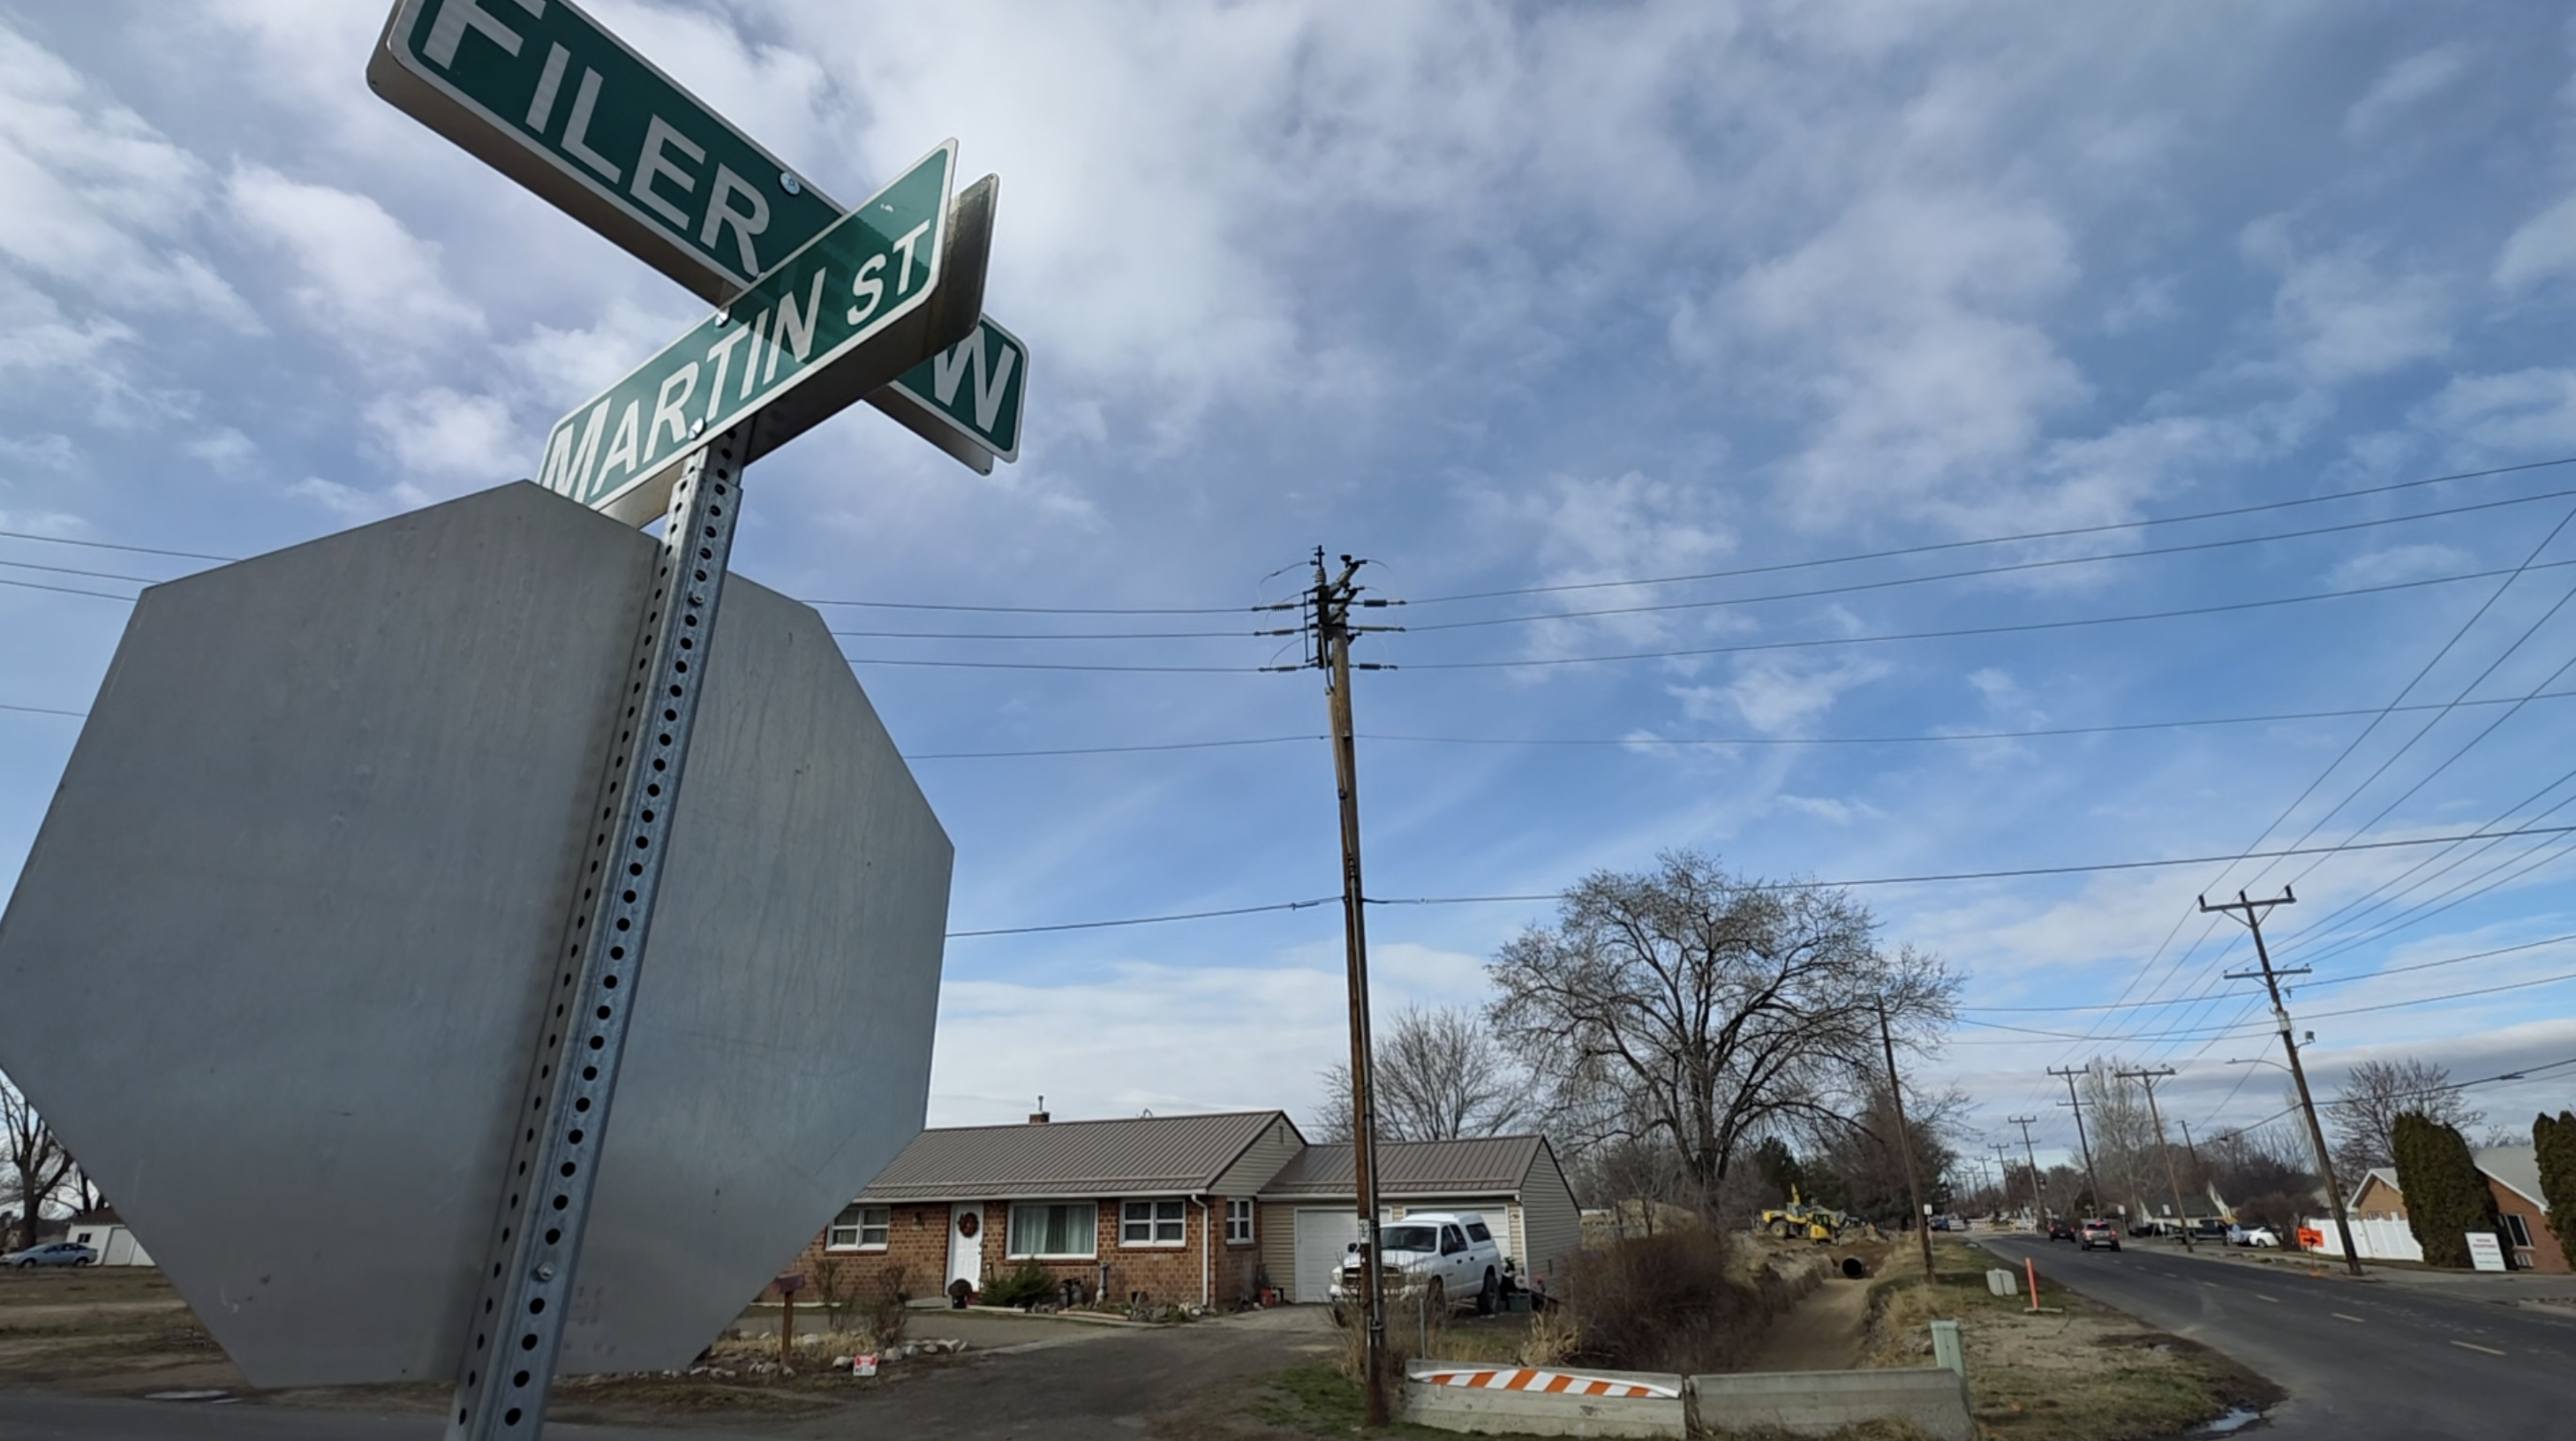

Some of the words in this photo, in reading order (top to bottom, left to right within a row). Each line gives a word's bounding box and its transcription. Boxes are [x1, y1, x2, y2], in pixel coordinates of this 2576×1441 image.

[422, 0, 770, 276] FILER
[934, 325, 1016, 434] W
[542, 268, 826, 503] MARTIN
[847, 220, 930, 326] ST
